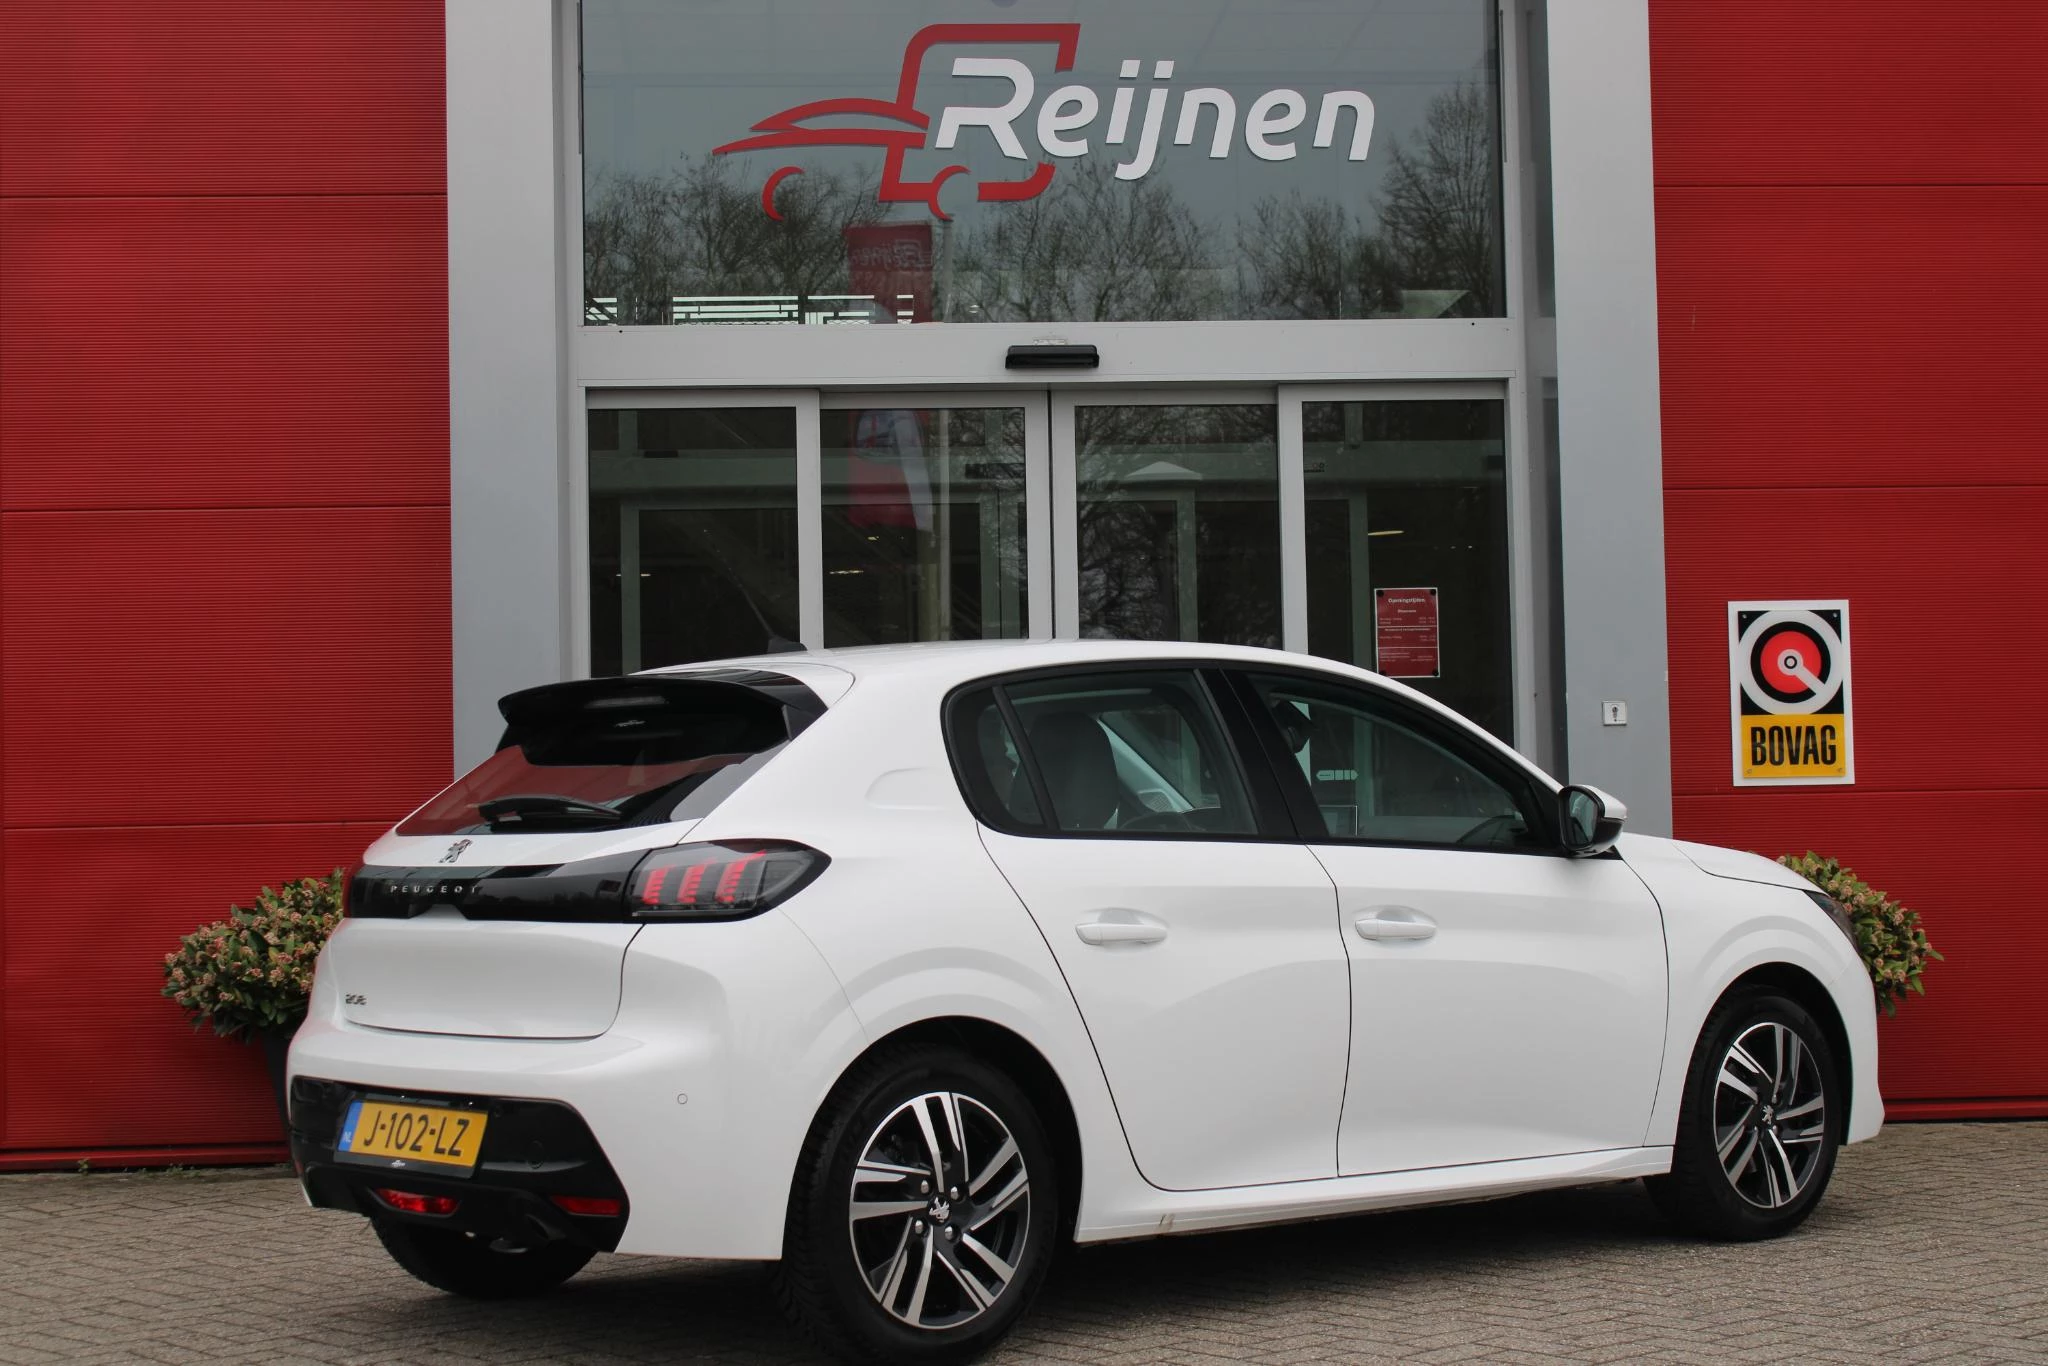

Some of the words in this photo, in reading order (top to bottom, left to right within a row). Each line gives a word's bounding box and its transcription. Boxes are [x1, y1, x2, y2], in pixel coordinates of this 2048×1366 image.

[935, 57, 1375, 180] Reijnen
[1750, 725, 1837, 766] BOVAG
[391, 885, 478, 894] PEUGEOT
[342, 1131, 352, 1143] NL
[363, 1110, 470, 1157] J-102-LZ
